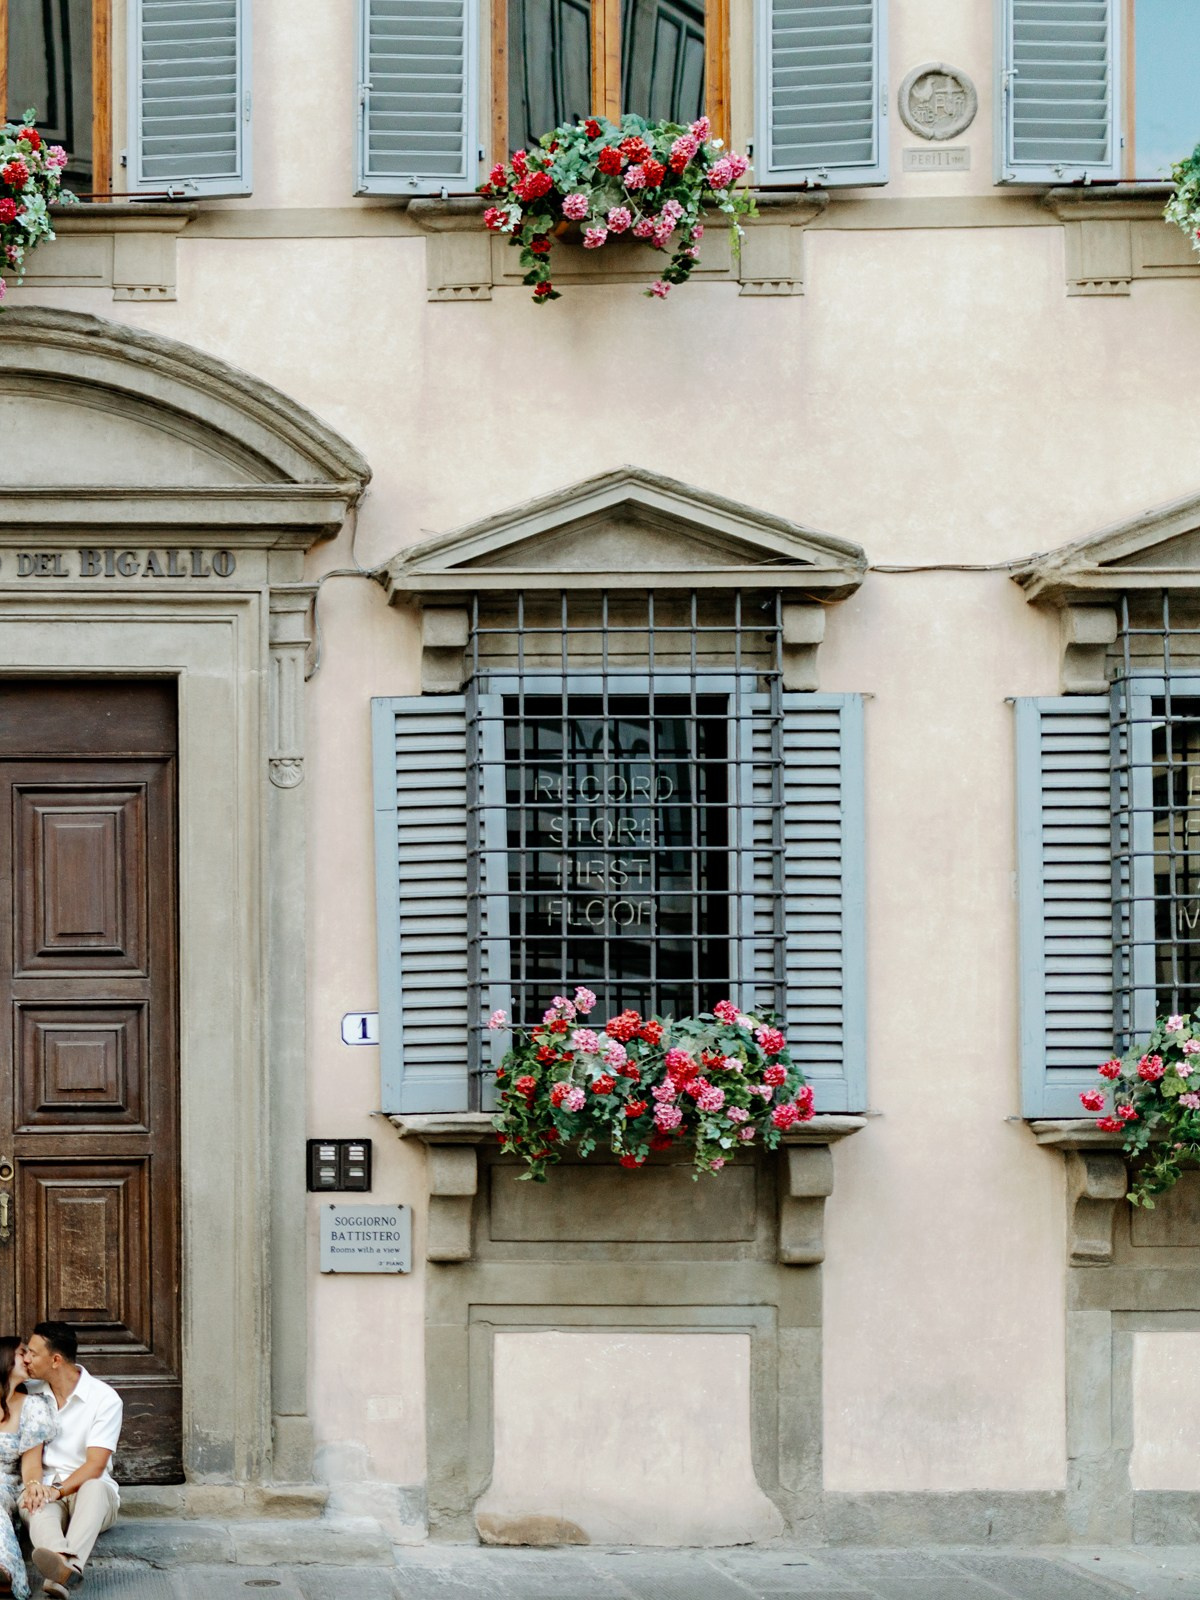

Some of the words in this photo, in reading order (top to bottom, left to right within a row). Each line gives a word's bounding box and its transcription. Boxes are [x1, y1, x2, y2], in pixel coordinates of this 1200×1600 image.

[17, 552, 69, 578] DEL
[79, 548, 237, 578] BIGALLO
[534, 774, 674, 802] RECORD
[549, 816, 660, 844] STORE
[556, 858, 649, 885] FIRST
[547, 899, 658, 928] FLOOR
[357, 1017, 371, 1040] 1
[335, 1216, 397, 1226] SOGGIORNO
[330, 1245, 356, 1254] Rooms
[357, 1245, 375, 1254] with
[383, 1246, 400, 1254] view
[331, 1231, 400, 1241] BATTISTERO
